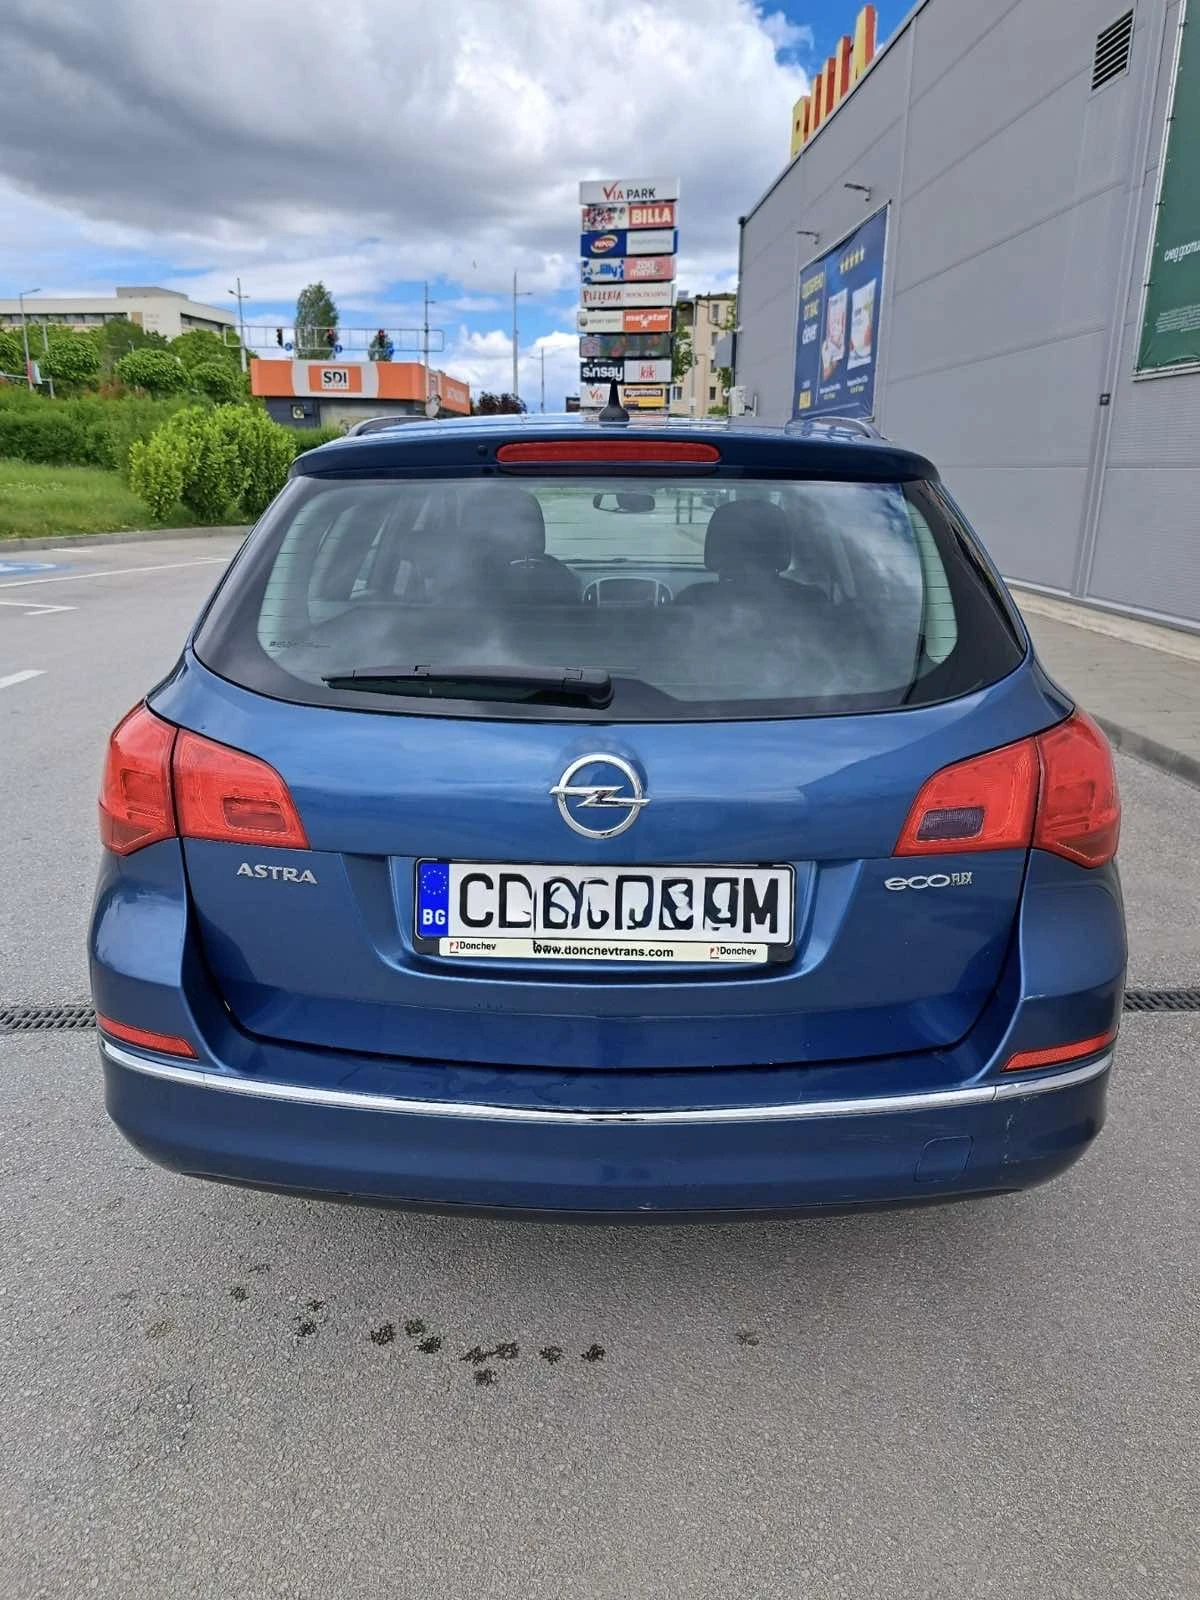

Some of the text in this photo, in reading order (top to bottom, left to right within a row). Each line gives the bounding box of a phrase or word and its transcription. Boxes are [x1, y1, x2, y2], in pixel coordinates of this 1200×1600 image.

[626, 188, 656, 199] PARK
[631, 207, 672, 224] BILLA
[323, 371, 347, 384] SDI
[582, 364, 623, 381] sinsay
[236, 862, 318, 884] ASTRA
[422, 908, 446, 925] BG
[459, 941, 496, 950] Donchev
[719, 946, 757, 956] Donchev
